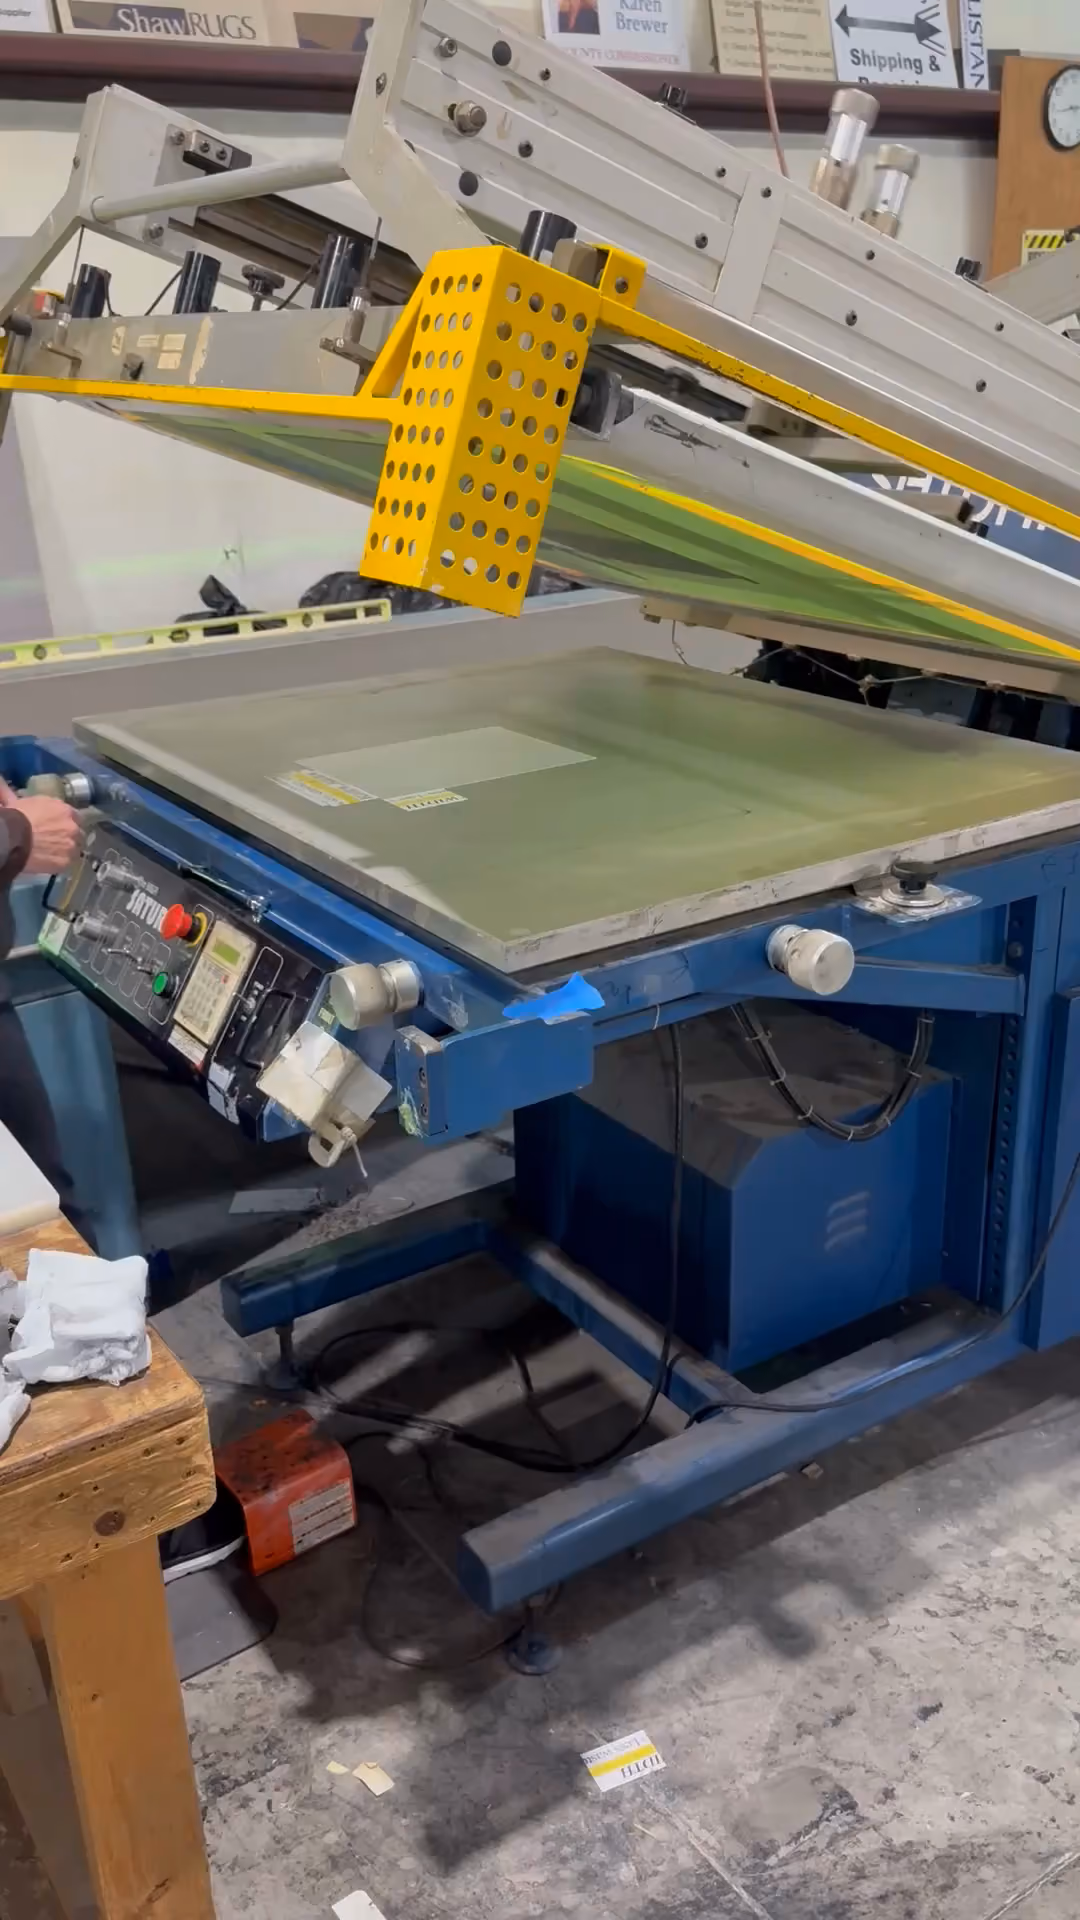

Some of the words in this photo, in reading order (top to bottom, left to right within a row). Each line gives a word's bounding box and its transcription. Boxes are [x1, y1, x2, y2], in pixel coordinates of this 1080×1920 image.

[615, 11, 669, 34] Brewer
[850, 48, 923, 75] Shipping
[929, 55, 941, 72] &
[125, 889, 168, 934] SATUR
